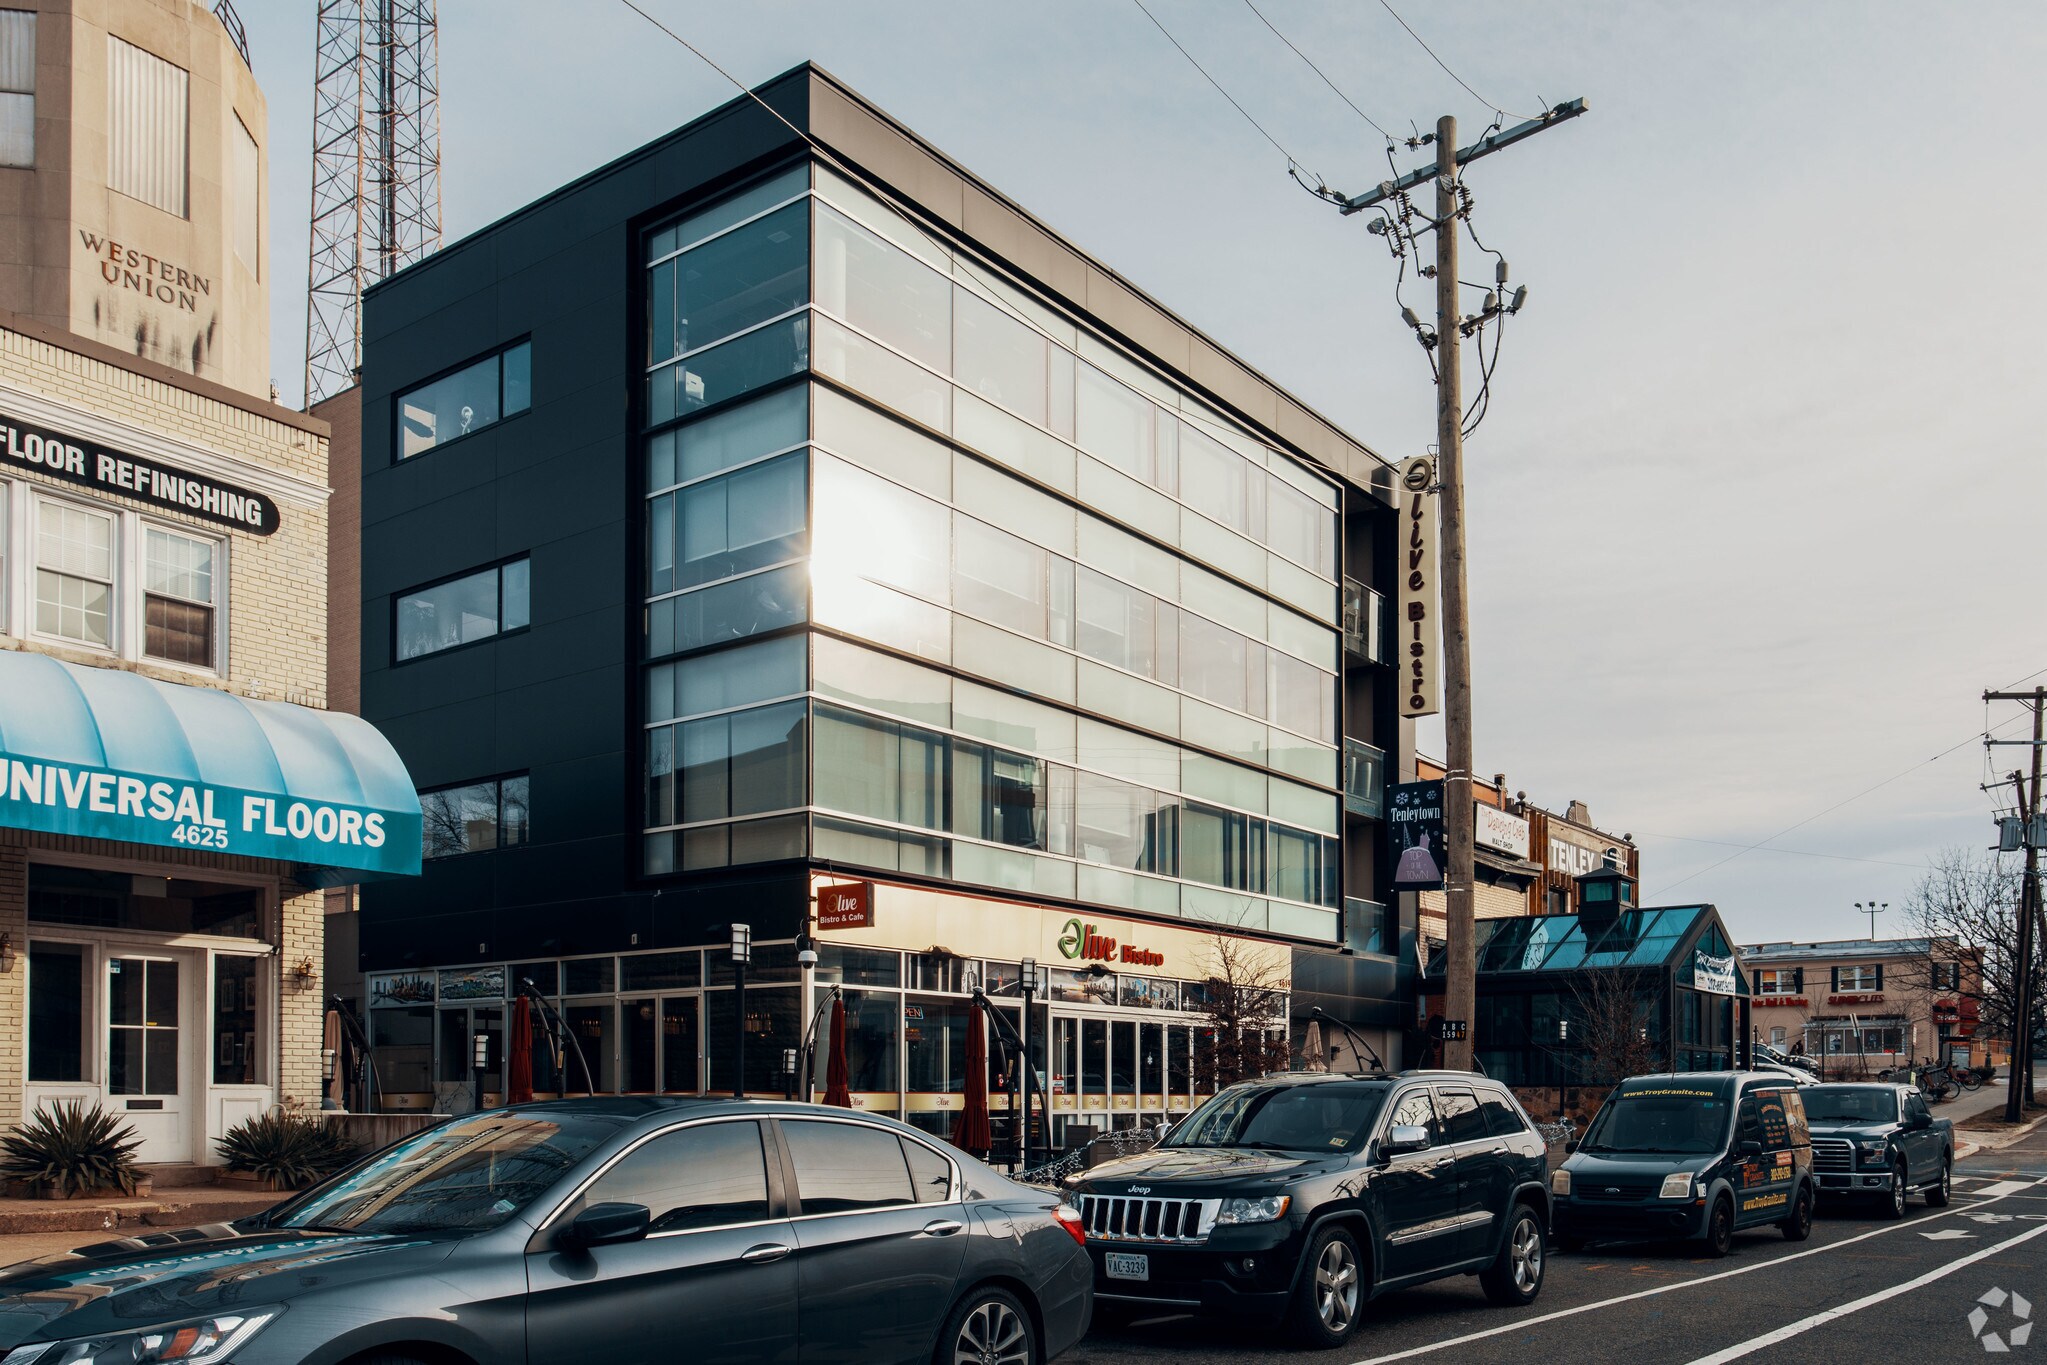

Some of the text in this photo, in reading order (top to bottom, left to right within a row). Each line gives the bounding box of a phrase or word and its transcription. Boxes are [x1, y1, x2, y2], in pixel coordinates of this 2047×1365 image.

[79, 229, 210, 296] WESTERN
[100, 260, 196, 313] UNION
[97, 454, 262, 526] REFINISHING
[1408, 601, 1425, 710] Bistro
[243, 796, 386, 848] FLOORS
[1390, 806, 1440, 822] Tenleytown
[172, 824, 229, 848] 4625
[1409, 850, 1423, 861] TOP
[1551, 838, 1595, 876] TENLEY
[1406, 870, 1429, 880] TOWN
[820, 916, 840, 924] Bistro
[848, 912, 864, 921] Cafe
[1120, 945, 1164, 967] Bistro
[905, 1007, 921, 1017] PEN
[1623, 1089, 1714, 1098] www.TroyGranite.com
[1127, 1185, 1151, 1195] Jeep
[1108, 1260, 1146, 1274] VAC-3239
